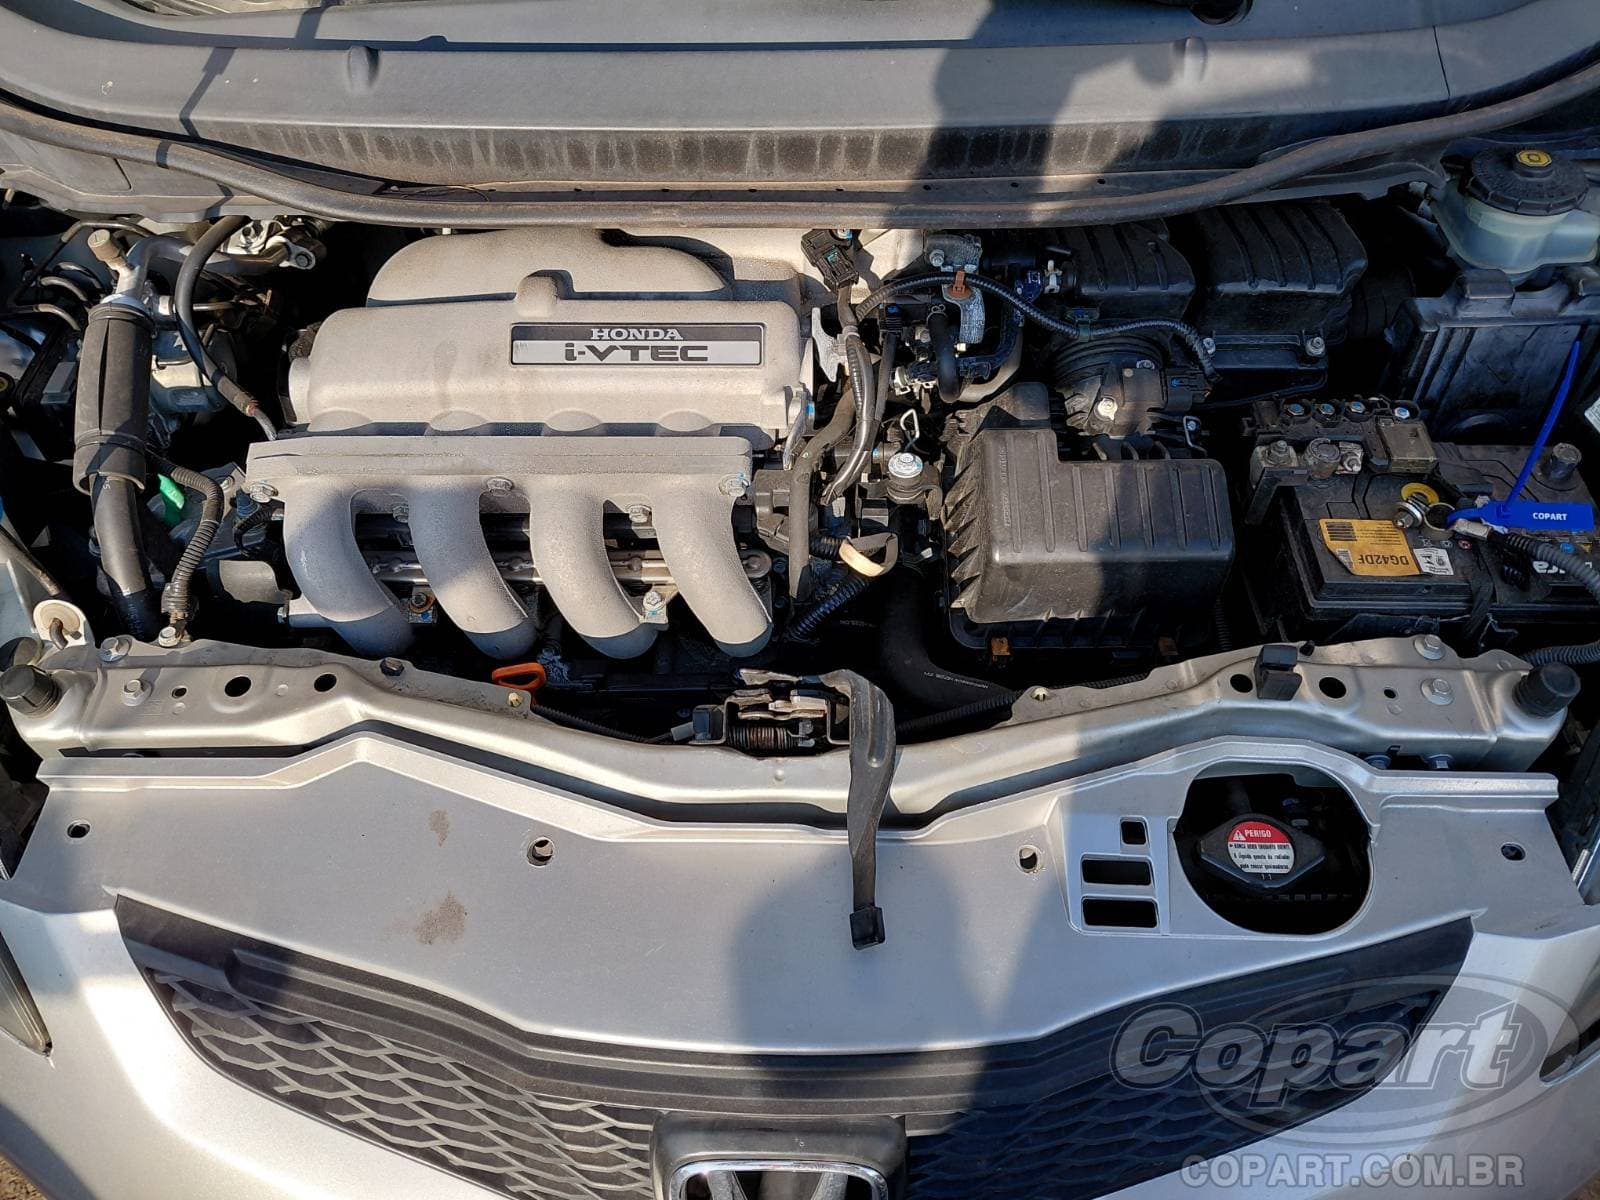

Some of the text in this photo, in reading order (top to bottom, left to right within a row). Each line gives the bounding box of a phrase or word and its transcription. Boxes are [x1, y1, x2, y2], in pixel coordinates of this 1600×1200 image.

[591, 328, 683, 340] HONDA
[564, 342, 708, 361] i-VTEC
[1532, 512, 1568, 520] COPART
[1244, 829, 1271, 837] PERIGO
